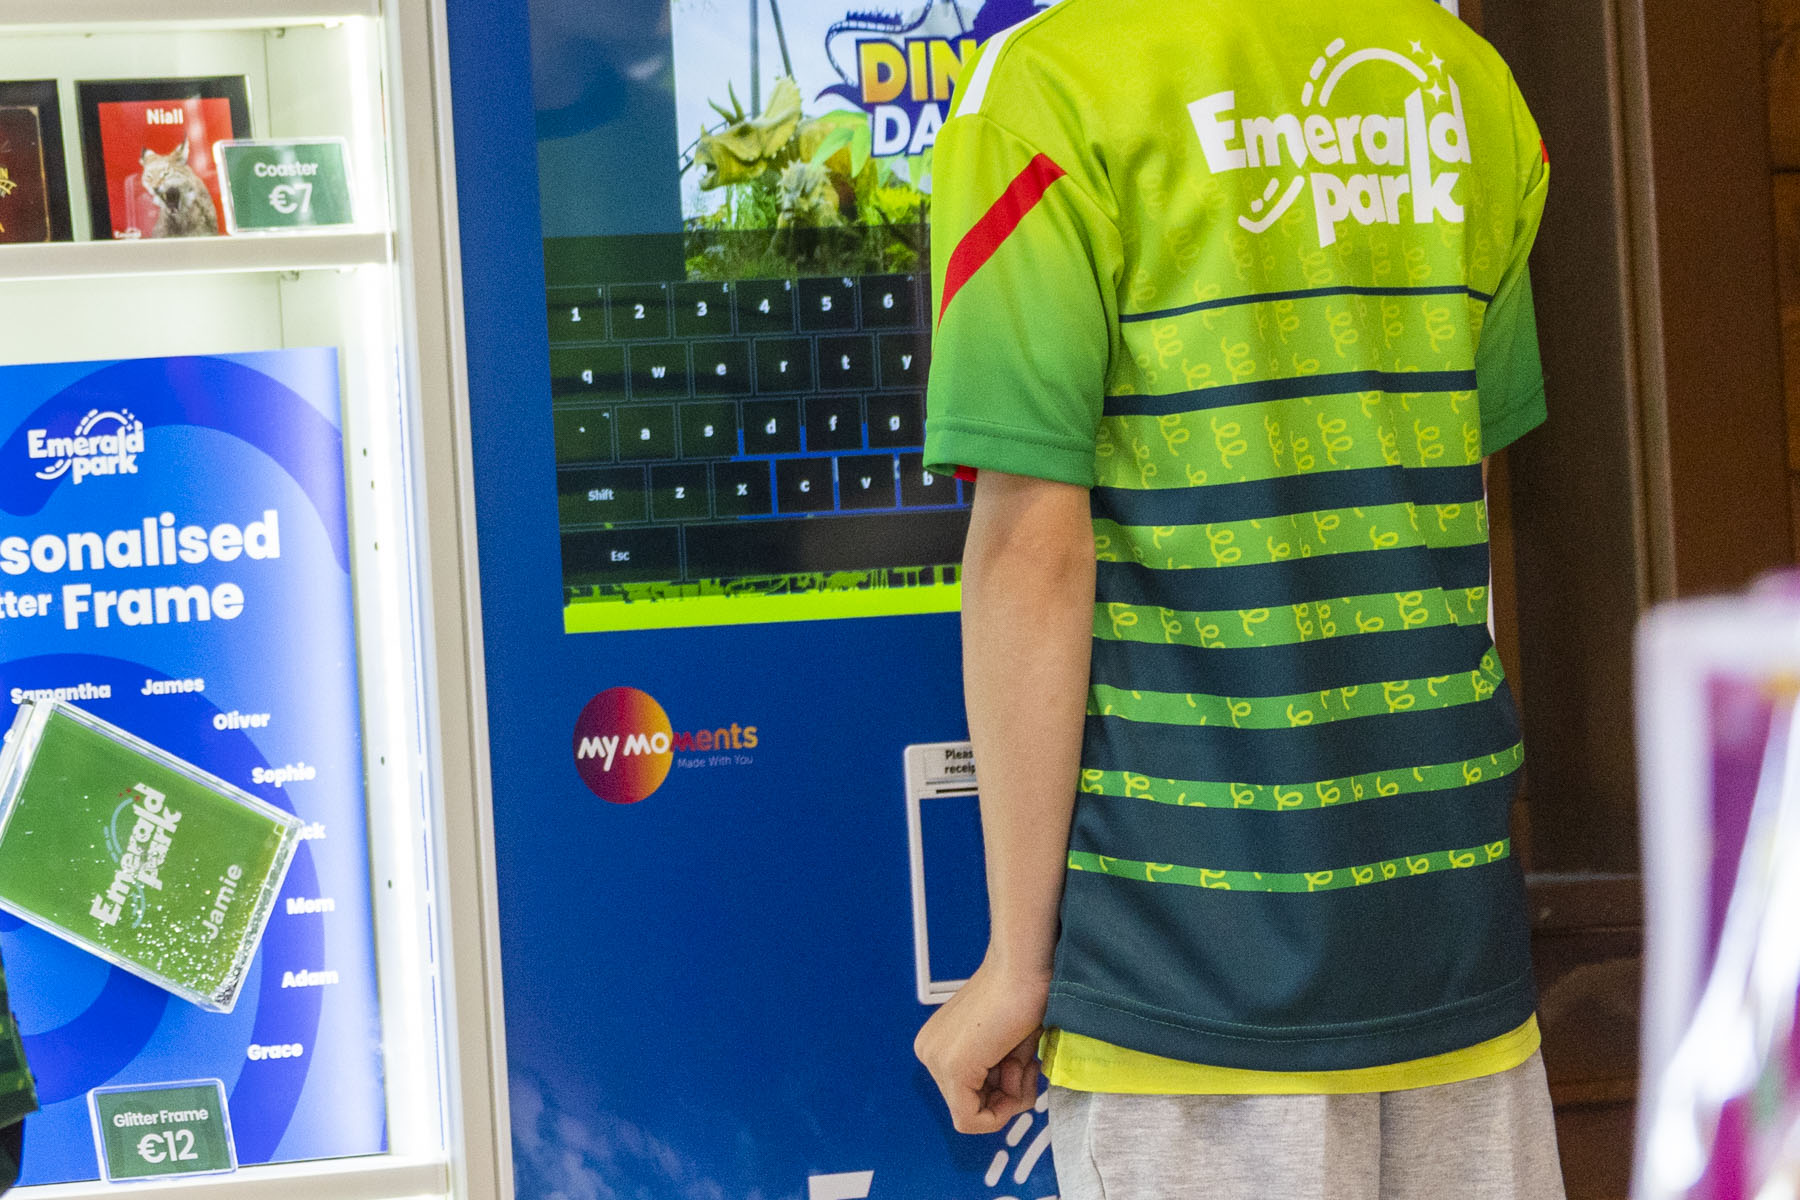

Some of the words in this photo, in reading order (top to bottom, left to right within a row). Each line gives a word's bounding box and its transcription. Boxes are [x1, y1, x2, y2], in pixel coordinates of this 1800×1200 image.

[859, 39, 978, 103] DIN
[146, 107, 184, 126] Niall
[873, 103, 944, 156] DA
[1187, 75, 1472, 174] Emerald
[254, 159, 319, 179] Coaster
[268, 183, 313, 215] €7
[1311, 169, 1465, 248] park
[571, 307, 581, 322] 1
[634, 304, 645, 319] 2
[697, 301, 708, 317] 3
[759, 299, 770, 314] 4
[821, 296, 832, 312] 5
[883, 293, 894, 309] 6
[582, 369, 593, 384] q
[651, 366, 666, 379] w
[716, 363, 727, 376] e
[780, 360, 788, 373] r
[841, 354, 850, 370] t
[901, 354, 912, 370] y
[27, 421, 145, 460] Emerald
[640, 428, 650, 441] a
[704, 424, 714, 437] s
[765, 418, 777, 434] d
[829, 414, 838, 432] f
[889, 415, 900, 431] g
[588, 489, 614, 501] Shift
[675, 487, 685, 499] z
[737, 483, 748, 496] x
[800, 480, 810, 492] c
[861, 477, 871, 489] v
[922, 471, 934, 486] b
[611, 551, 630, 562] Esc
[62, 581, 245, 631] Frame
[10, 682, 112, 704] Samantha
[140, 677, 206, 697] James
[212, 710, 271, 731] Oliver
[678, 758, 705, 768] Made
[708, 755, 732, 766] With
[735, 754, 753, 764] You
[945, 749, 973, 760] Pleas
[251, 761, 317, 788] Sophie
[89, 782, 167, 927] Emerald
[202, 863, 243, 940] Jamie
[286, 897, 335, 915] Mom
[281, 969, 339, 988] Adam
[247, 1042, 304, 1062] Grace
[113, 1111, 159, 1127] Glitter
[160, 1107, 209, 1124] Frame
[137, 1130, 198, 1164] €12
